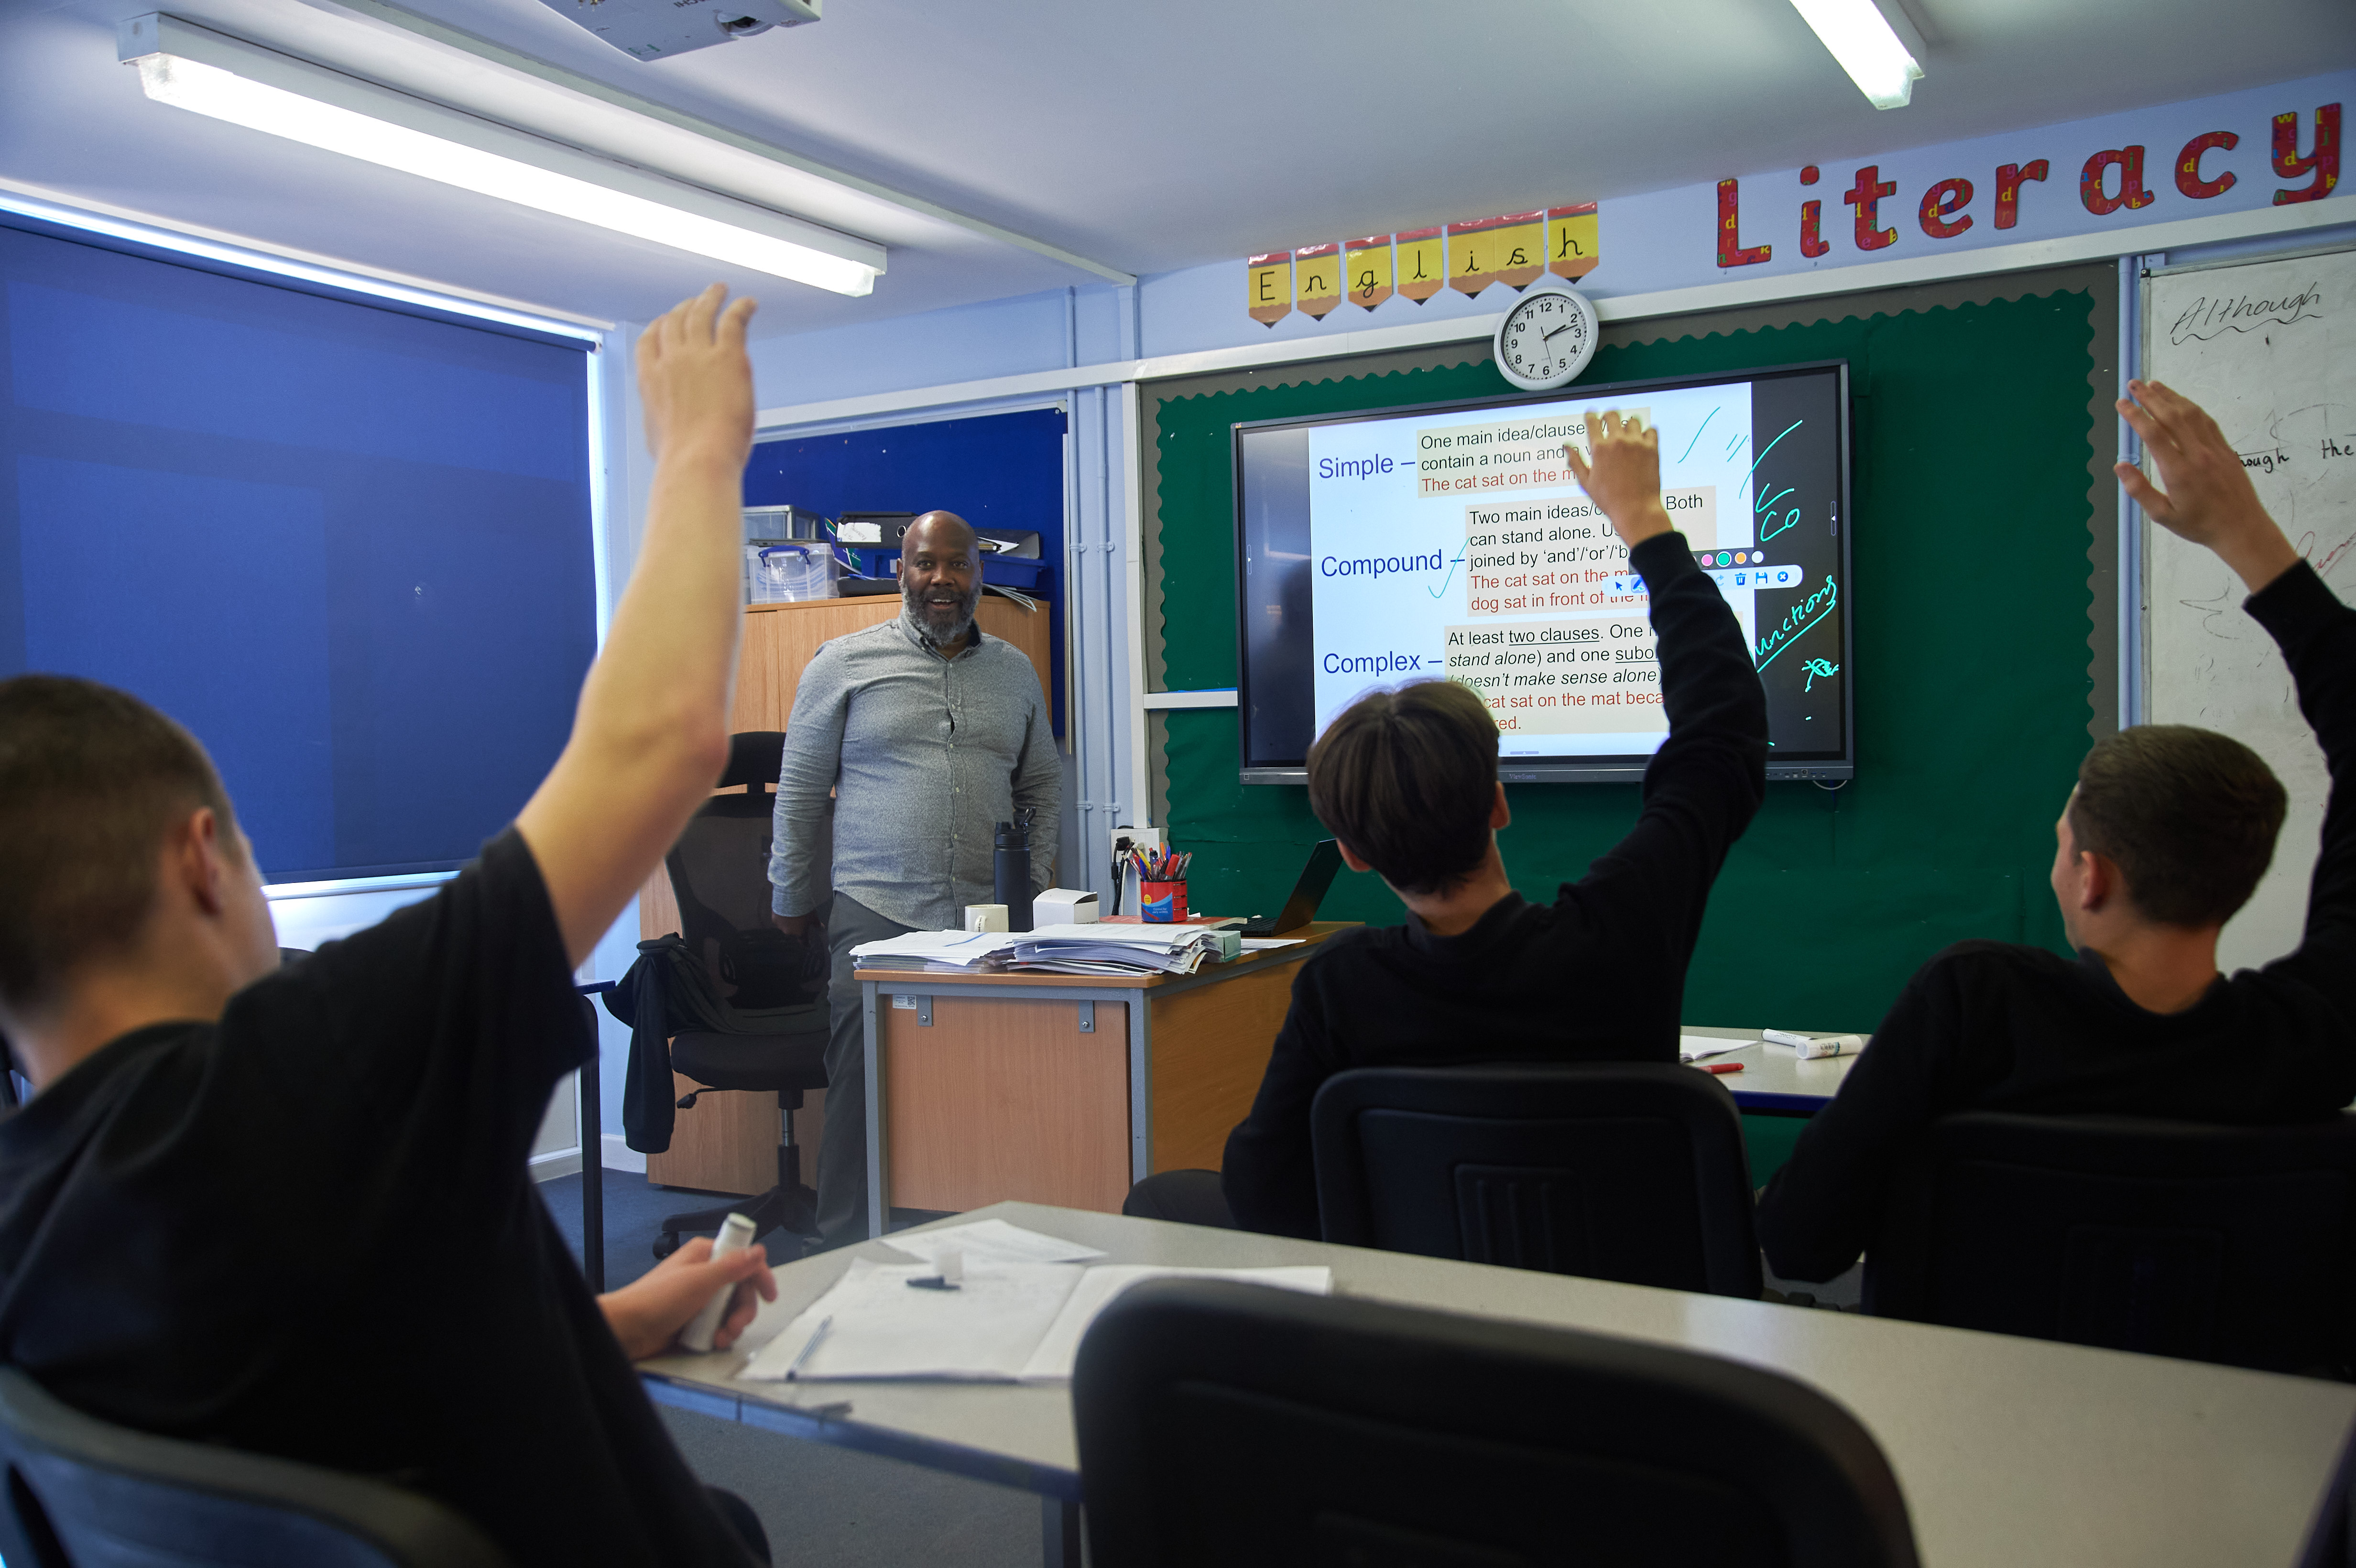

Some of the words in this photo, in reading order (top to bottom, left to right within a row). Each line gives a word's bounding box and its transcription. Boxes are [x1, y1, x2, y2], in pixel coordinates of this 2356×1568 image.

[1717, 102, 2342, 268] Literacy
[1260, 228, 1583, 301] English
[1525, 310, 1533, 319] 11
[1539, 302, 1552, 313] 12
[1559, 304, 1563, 313] 1
[2170, 281, 2320, 336] Although
[1515, 323, 1525, 333] 10
[1571, 314, 1577, 323] 2
[1574, 328, 1582, 338] 3
[1511, 339, 1517, 348] 9
[1570, 345, 1577, 354] 4
[1515, 355, 1522, 364] 8
[1528, 364, 1535, 373] 7
[1559, 359, 1566, 368] 5
[1543, 366, 1549, 375] 6
[1421, 435, 1451, 449] One
[1457, 430, 1492, 446] main
[1498, 424, 1585, 442] idea/clause
[1421, 453, 1474, 471] contain
[1480, 455, 1488, 466] a
[1494, 451, 1531, 464] noun
[1537, 444, 1565, 460] and
[2321, 438, 2354, 459] the
[1319, 453, 1394, 481] Simple
[1421, 478, 1450, 492] The
[1455, 474, 1477, 490] cat
[1482, 472, 1505, 487] sat
[1509, 473, 1527, 485] on
[1533, 468, 1557, 483] the
[1469, 511, 1500, 525] Two
[1505, 506, 1541, 523] main
[1548, 502, 1603, 519] ideas/c
[1666, 493, 1702, 510] Both
[1469, 533, 1496, 547] can
[1502, 527, 1543, 544] stand
[1549, 526, 1595, 541] alone.
[1321, 548, 1442, 579] Compound
[1469, 551, 1515, 572] joined
[1520, 551, 1538, 568] by
[1470, 575, 1500, 589] The
[1505, 573, 1527, 588] cat
[1532, 571, 1555, 586] sat
[1560, 573, 1579, 584] on
[1471, 597, 1499, 613] dog
[1504, 594, 1527, 609] sat
[1532, 593, 1544, 607] in
[1549, 591, 1585, 606] front
[1750, 575, 1837, 663] unctions
[1448, 632, 1464, 646] At
[1469, 630, 1505, 645] least
[1508, 630, 1535, 643] two
[1540, 627, 1603, 642] clauses.
[1610, 624, 1643, 639] One
[1323, 650, 1421, 677] Complex
[1449, 652, 1490, 667] stand
[1494, 649, 1541, 667] alone)
[1547, 648, 1575, 663] and
[1581, 650, 1610, 662] one
[1514, 671, 1556, 686] make
[1560, 673, 1607, 685] sense
[1613, 667, 1662, 686] alone)
[1483, 695, 1505, 708] cat
[1510, 694, 1533, 708] sat
[1538, 696, 1556, 707] on
[1561, 692, 1586, 707] the
[1592, 691, 1621, 706] mat
[1626, 690, 1664, 705] beca
